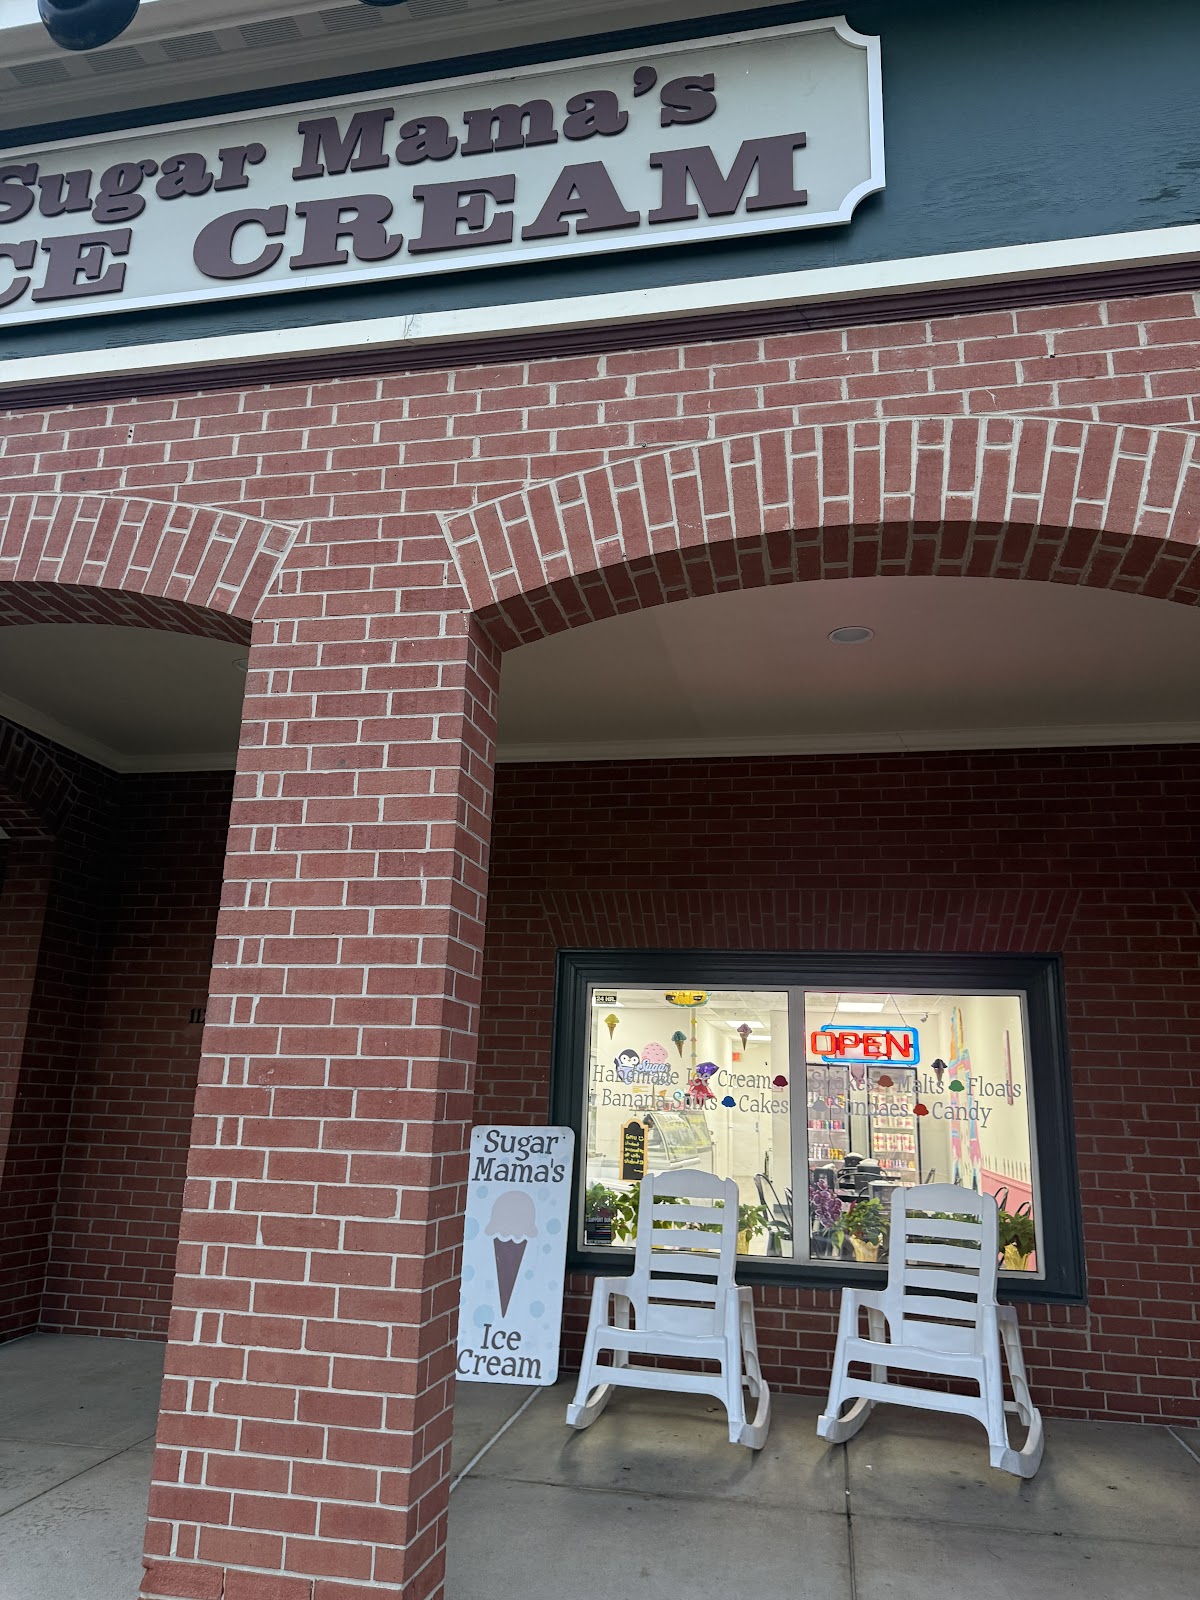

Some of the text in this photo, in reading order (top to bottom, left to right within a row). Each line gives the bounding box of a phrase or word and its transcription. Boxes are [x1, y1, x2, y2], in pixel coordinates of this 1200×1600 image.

[0, 66, 717, 223] Sugar Mama's
[193, 131, 808, 281] CREAM
[811, 1031, 911, 1058] OPEN
[592, 1063, 680, 1086] Handmade
[686, 1067, 711, 1087] Ice
[718, 1069, 772, 1090] Cream
[811, 1069, 1022, 1098] Shakes Malts Floats
[601, 1088, 789, 1115] Banana Splits Cakes
[832, 1095, 993, 1129] Sundaes Candy
[484, 1129, 559, 1161] Sugar
[471, 1156, 565, 1183] Mama's
[480, 1323, 521, 1351] Ice
[457, 1348, 542, 1380] Cream
